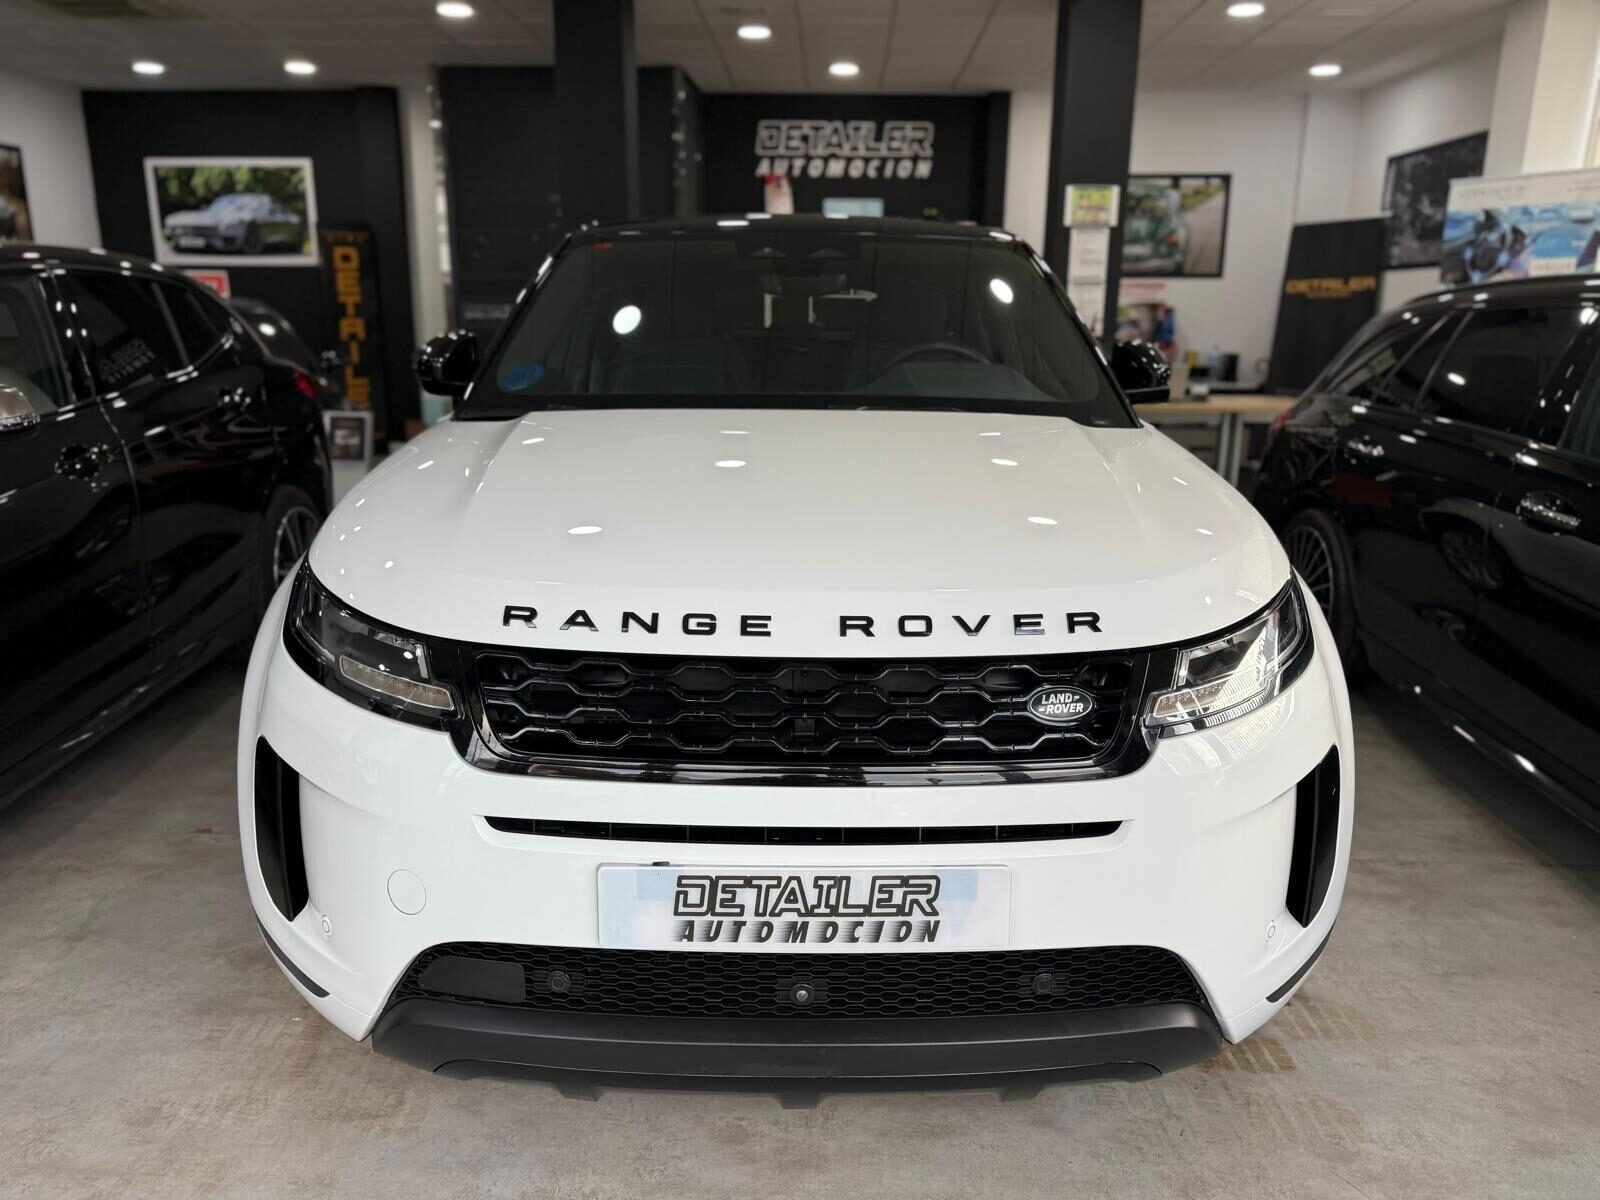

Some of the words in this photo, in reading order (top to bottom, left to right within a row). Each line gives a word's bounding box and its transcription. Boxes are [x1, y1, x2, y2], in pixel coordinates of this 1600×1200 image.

[755, 119, 935, 157] DETAILER
[755, 157, 933, 179] AUTOMOCION
[502, 605, 772, 637] RANGE
[839, 611, 1103, 637] ROVER
[1041, 692, 1073, 704] LAND
[1046, 702, 1084, 715] ROVER
[673, 875, 941, 917] DETAILER
[674, 919, 941, 944] AUTOMOCION
